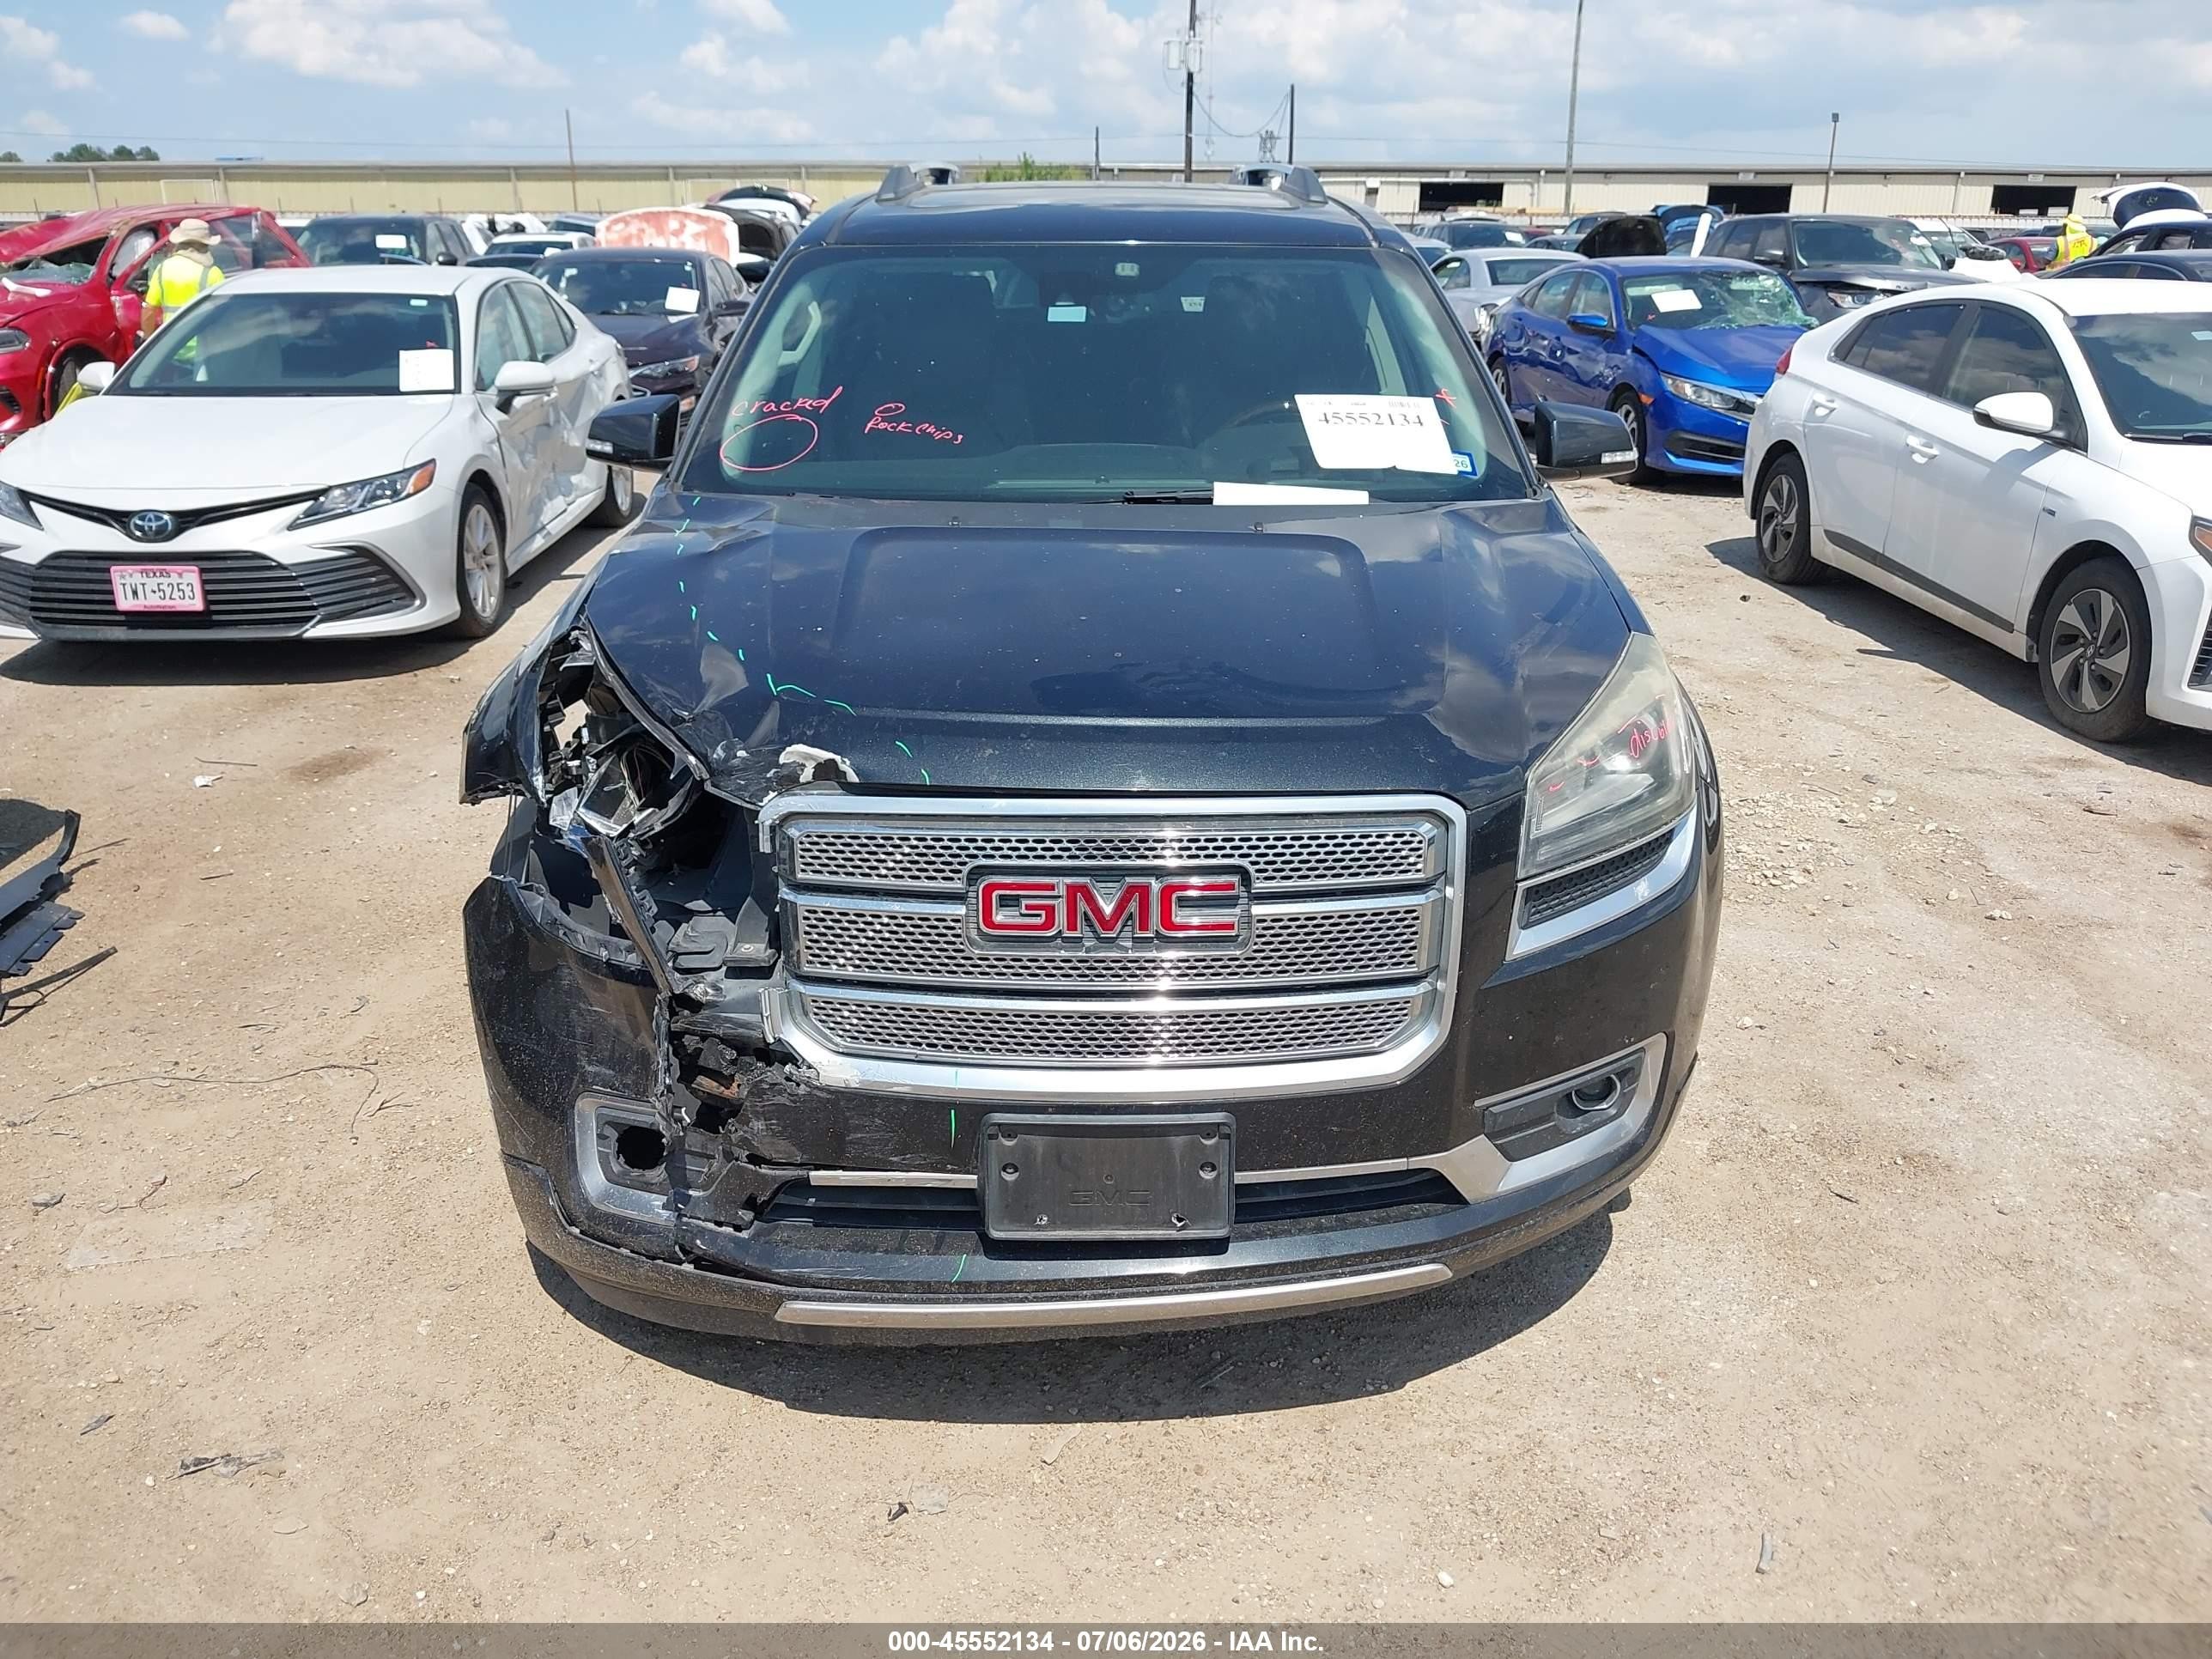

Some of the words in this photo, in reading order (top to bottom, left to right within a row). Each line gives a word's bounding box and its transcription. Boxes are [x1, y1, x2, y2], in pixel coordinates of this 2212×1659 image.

[864, 416, 914, 434] Rock
[1318, 411, 1424, 427] 45552134
[978, 877, 1242, 938] GMC
[1069, 1190, 1152, 1206] GMC
